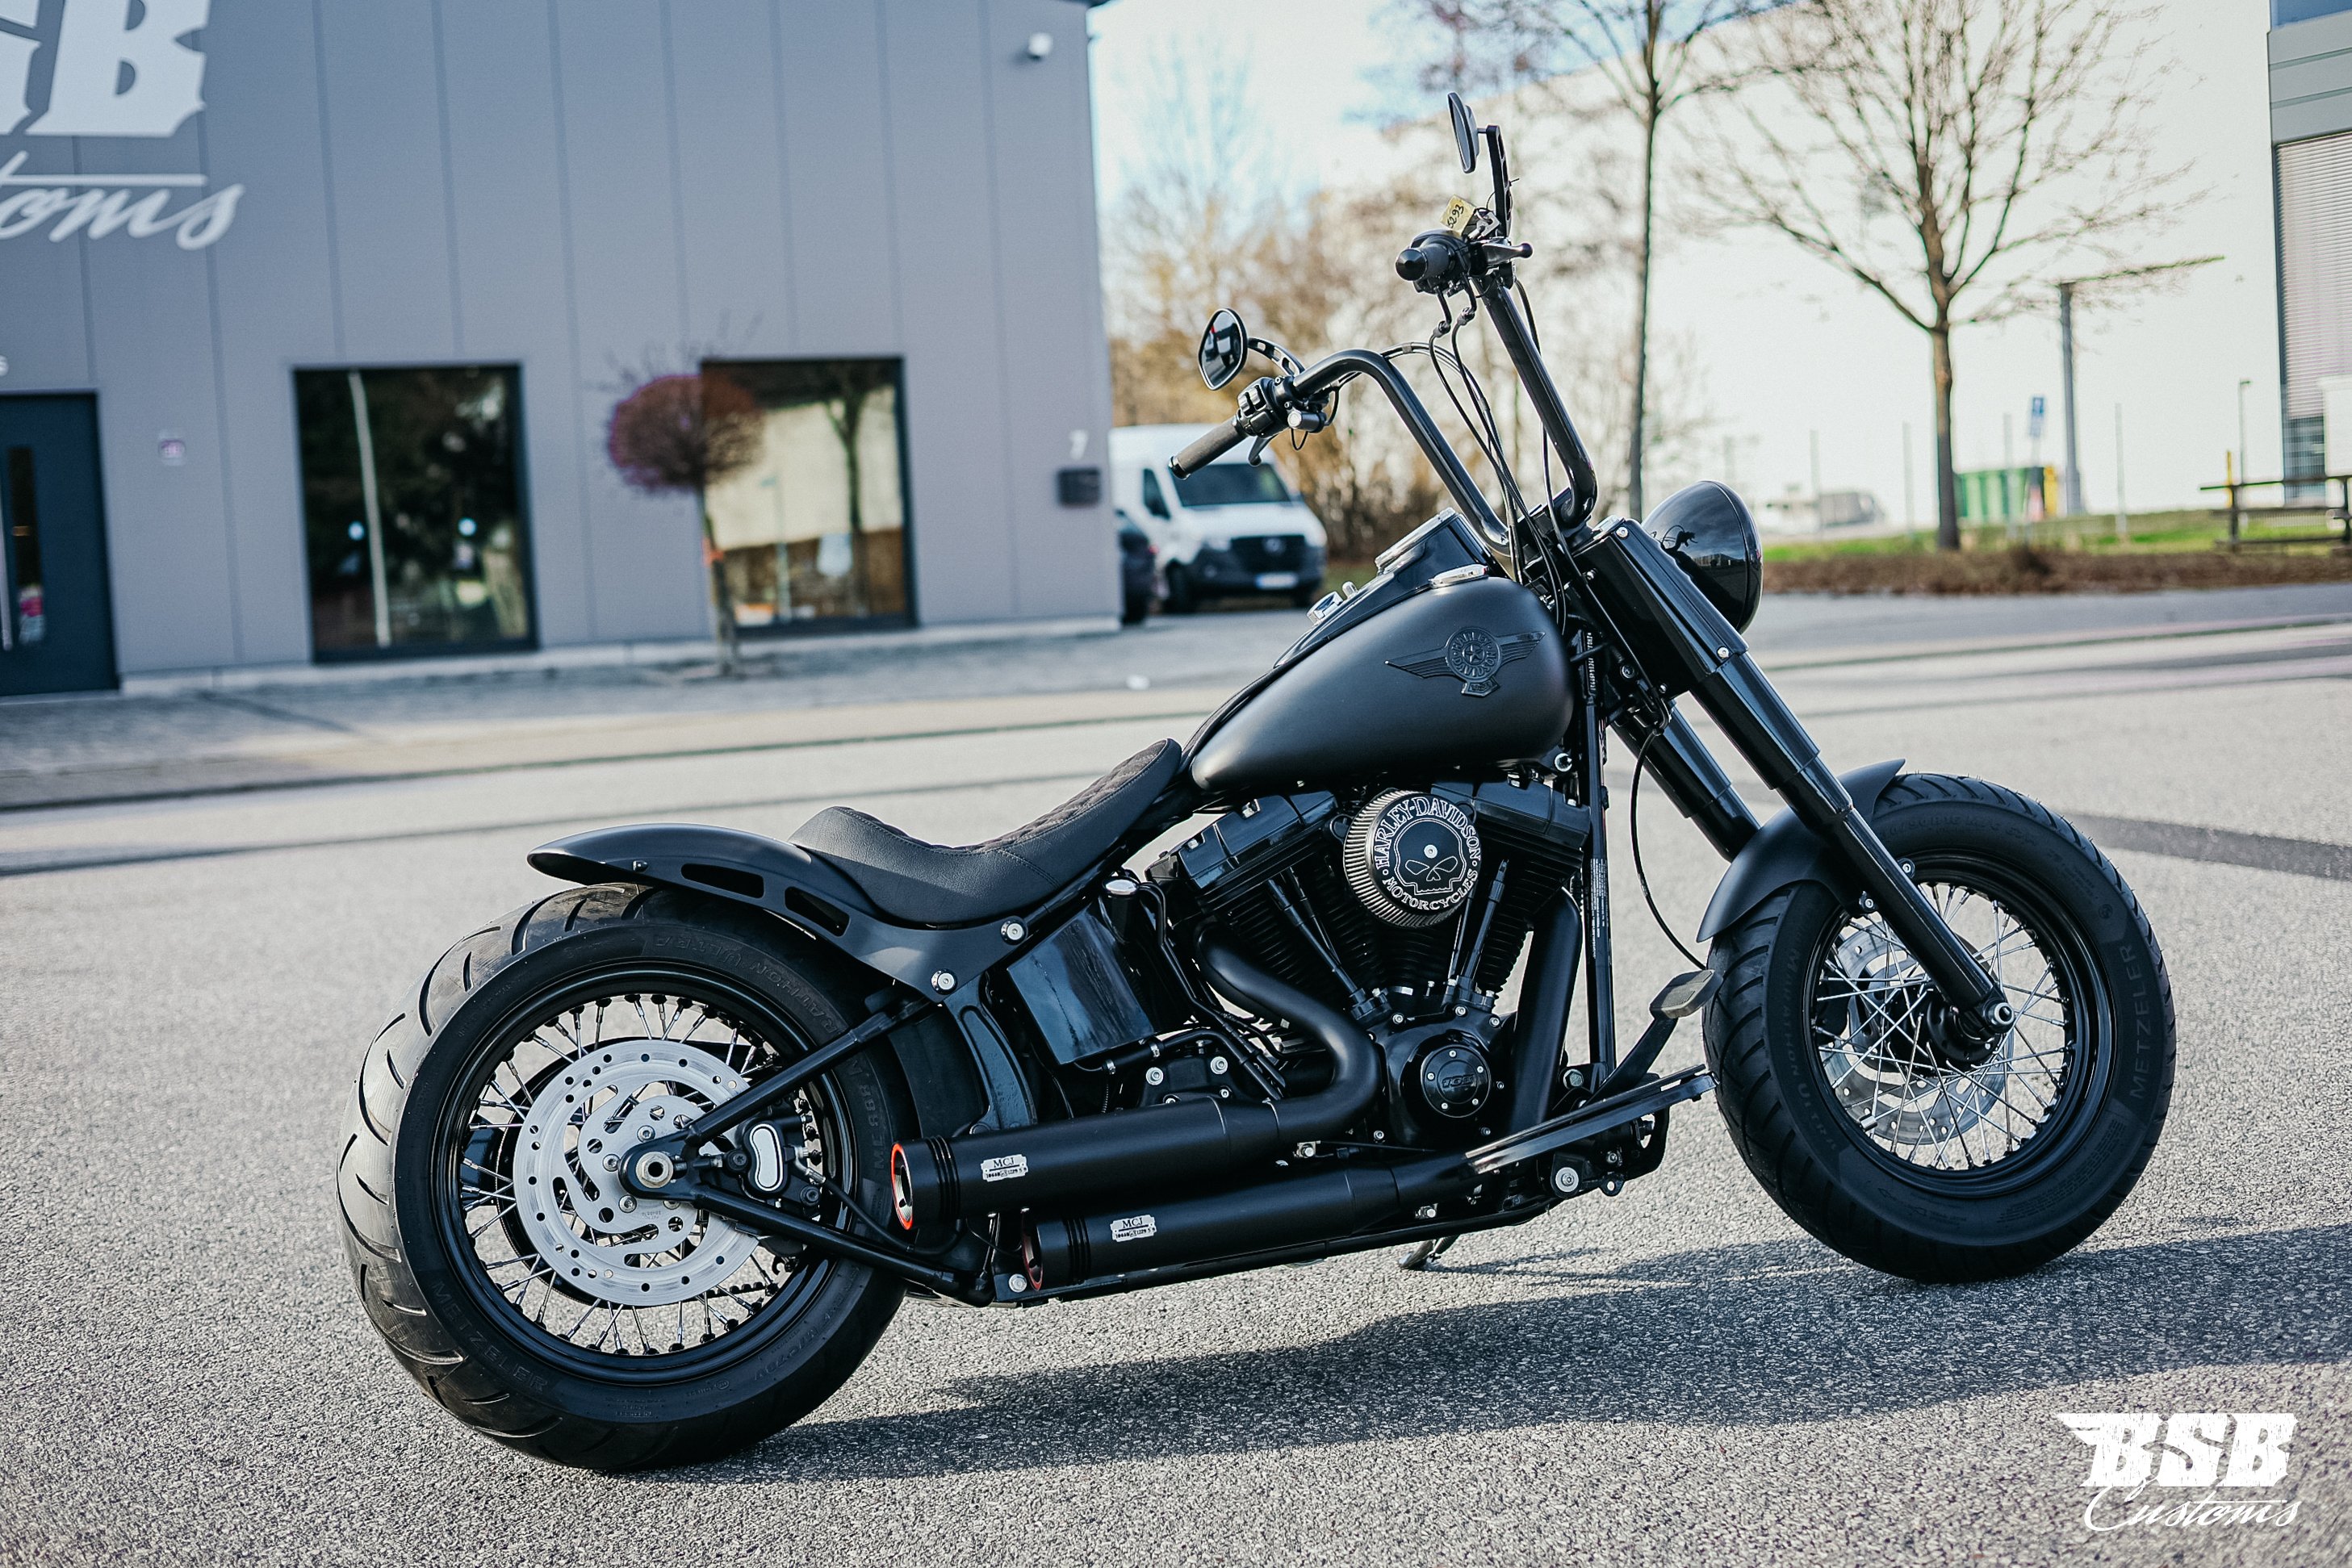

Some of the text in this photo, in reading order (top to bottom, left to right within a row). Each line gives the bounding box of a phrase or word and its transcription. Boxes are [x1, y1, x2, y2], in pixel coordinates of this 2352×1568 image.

[1069, 429, 1089, 459] 7
[1450, 631, 1492, 651] HARLEY
[1451, 650, 1497, 677] DAVIDSON
[1374, 797, 1481, 870] HARLEY-DAVIDSON
[1382, 868, 1479, 911] MOTORCYCLES
[2119, 943, 2151, 1099] METZELER
[993, 1156, 1015, 1169] MCJ
[1122, 1217, 1143, 1229] MCJ
[429, 1277, 546, 1393] METZELER
